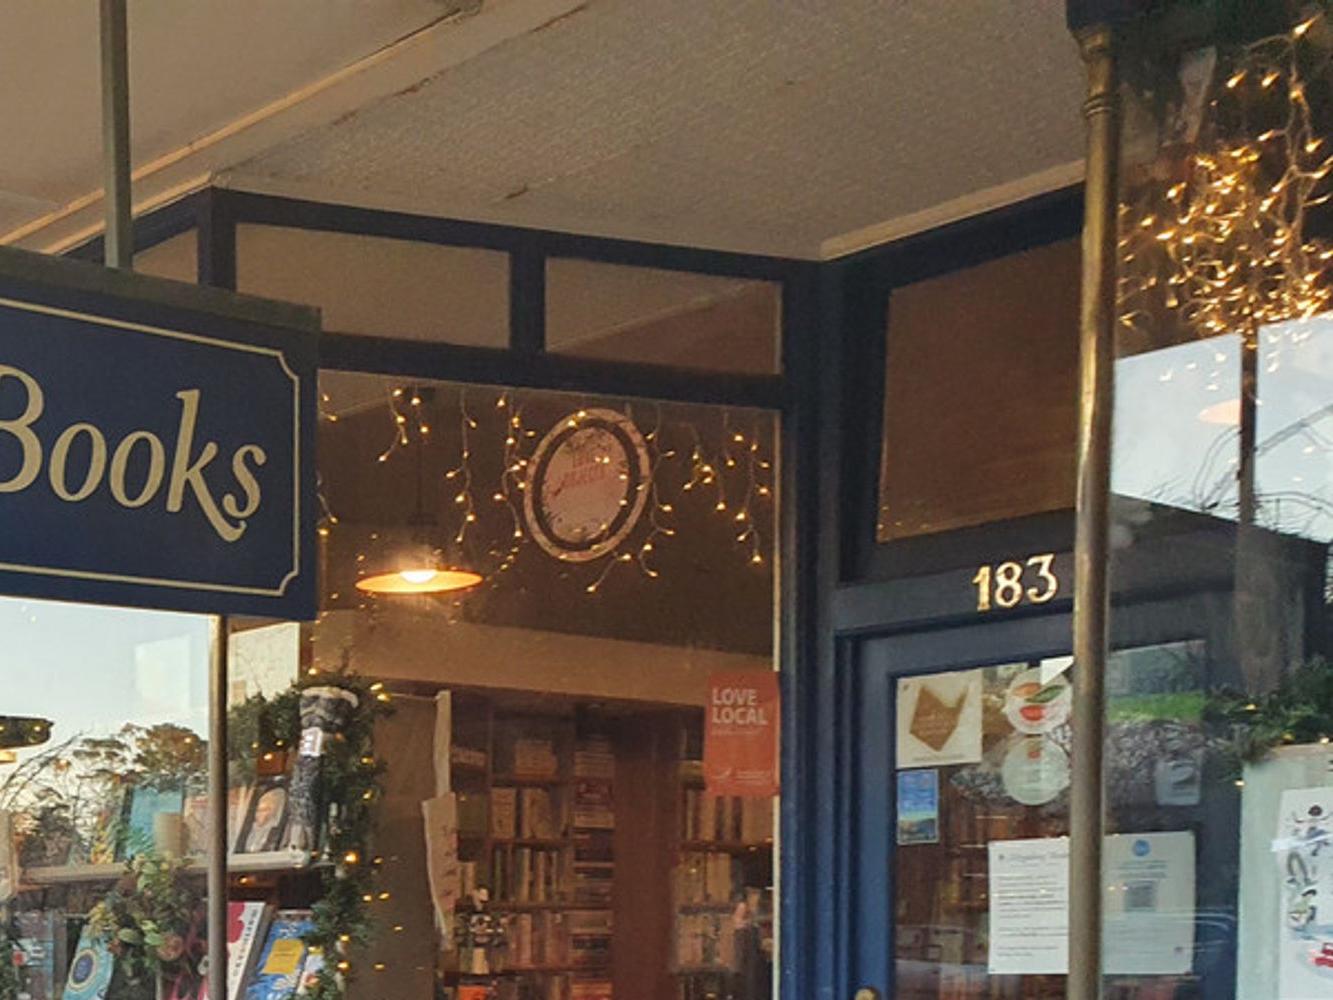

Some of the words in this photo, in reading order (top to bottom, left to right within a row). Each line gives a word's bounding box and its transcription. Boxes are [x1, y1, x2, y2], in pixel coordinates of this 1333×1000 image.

[972, 553, 1058, 612] 183
[712, 687, 758, 706] LOVE
[712, 706, 768, 726] LOCAL
